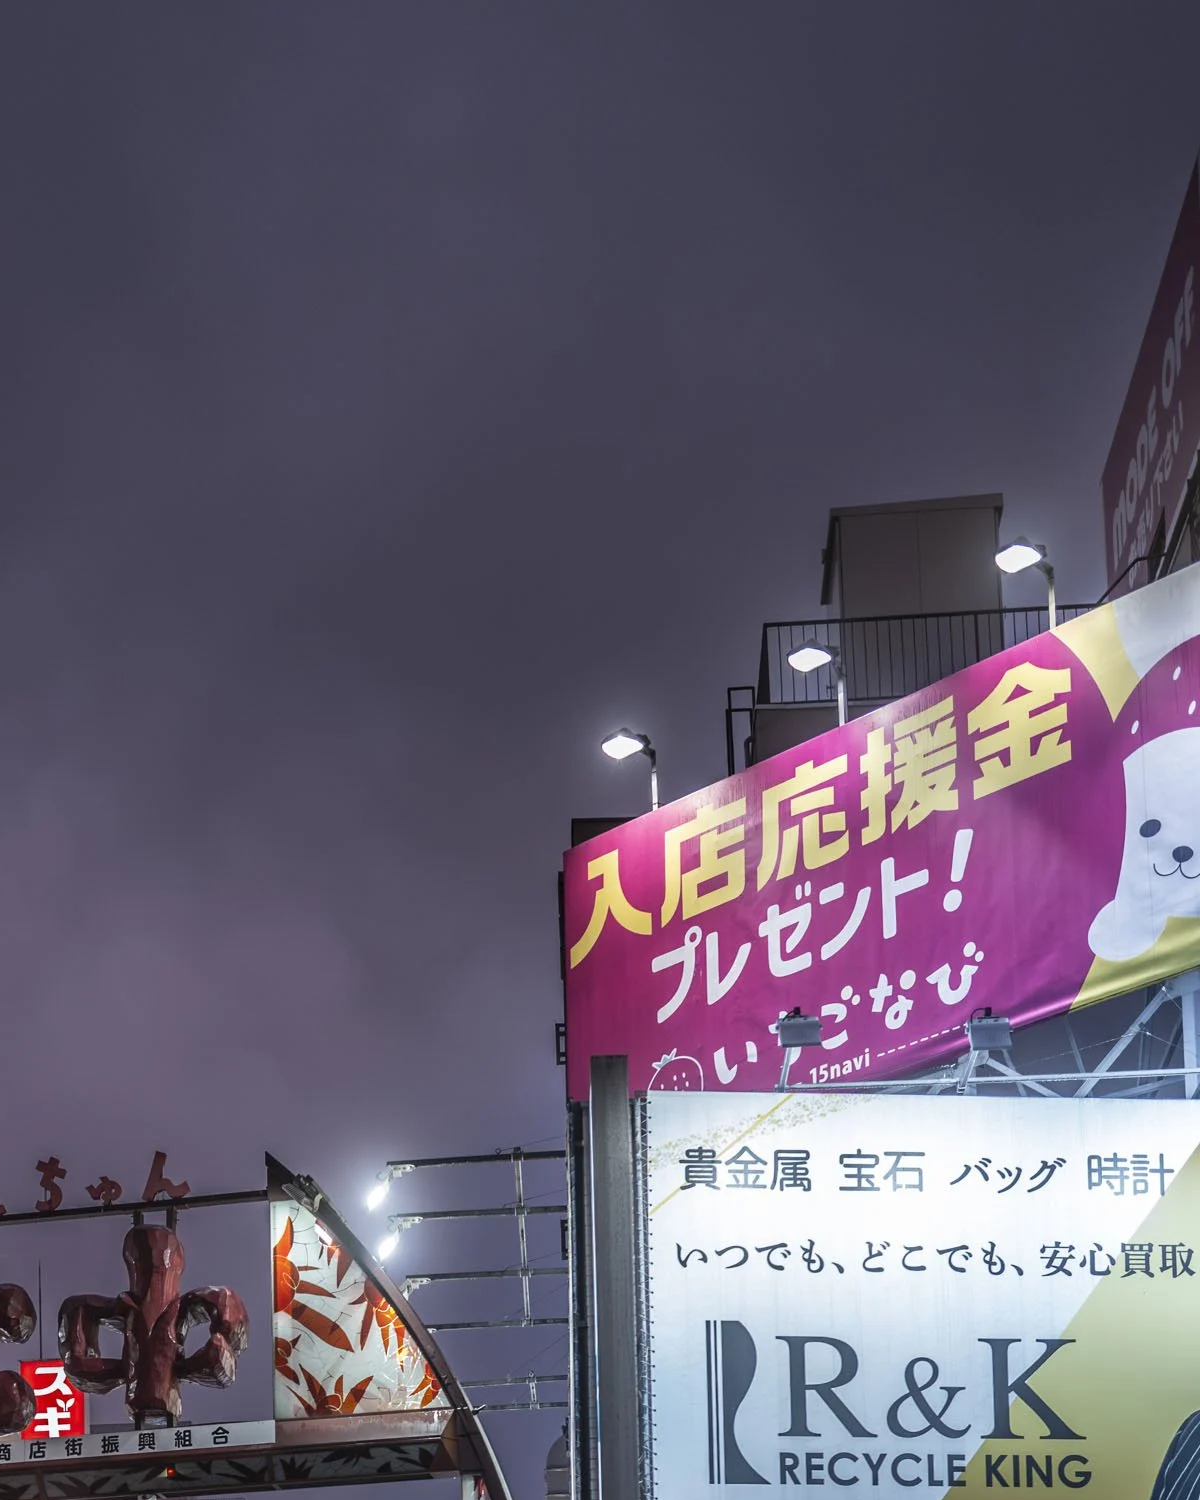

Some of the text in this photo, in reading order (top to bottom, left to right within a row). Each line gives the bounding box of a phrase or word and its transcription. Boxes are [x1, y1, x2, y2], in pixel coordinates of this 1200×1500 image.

[1112, 266, 1194, 571] MODE OFF
[569, 661, 1073, 970] 入店応援金
[809, 1048, 871, 1083] 15navi
[679, 1145, 1176, 1197] 貴金属 宝石 バッグ 時計
[776, 1335, 1088, 1441] R&K
[779, 1452, 1094, 1489] RECYCLE KING
